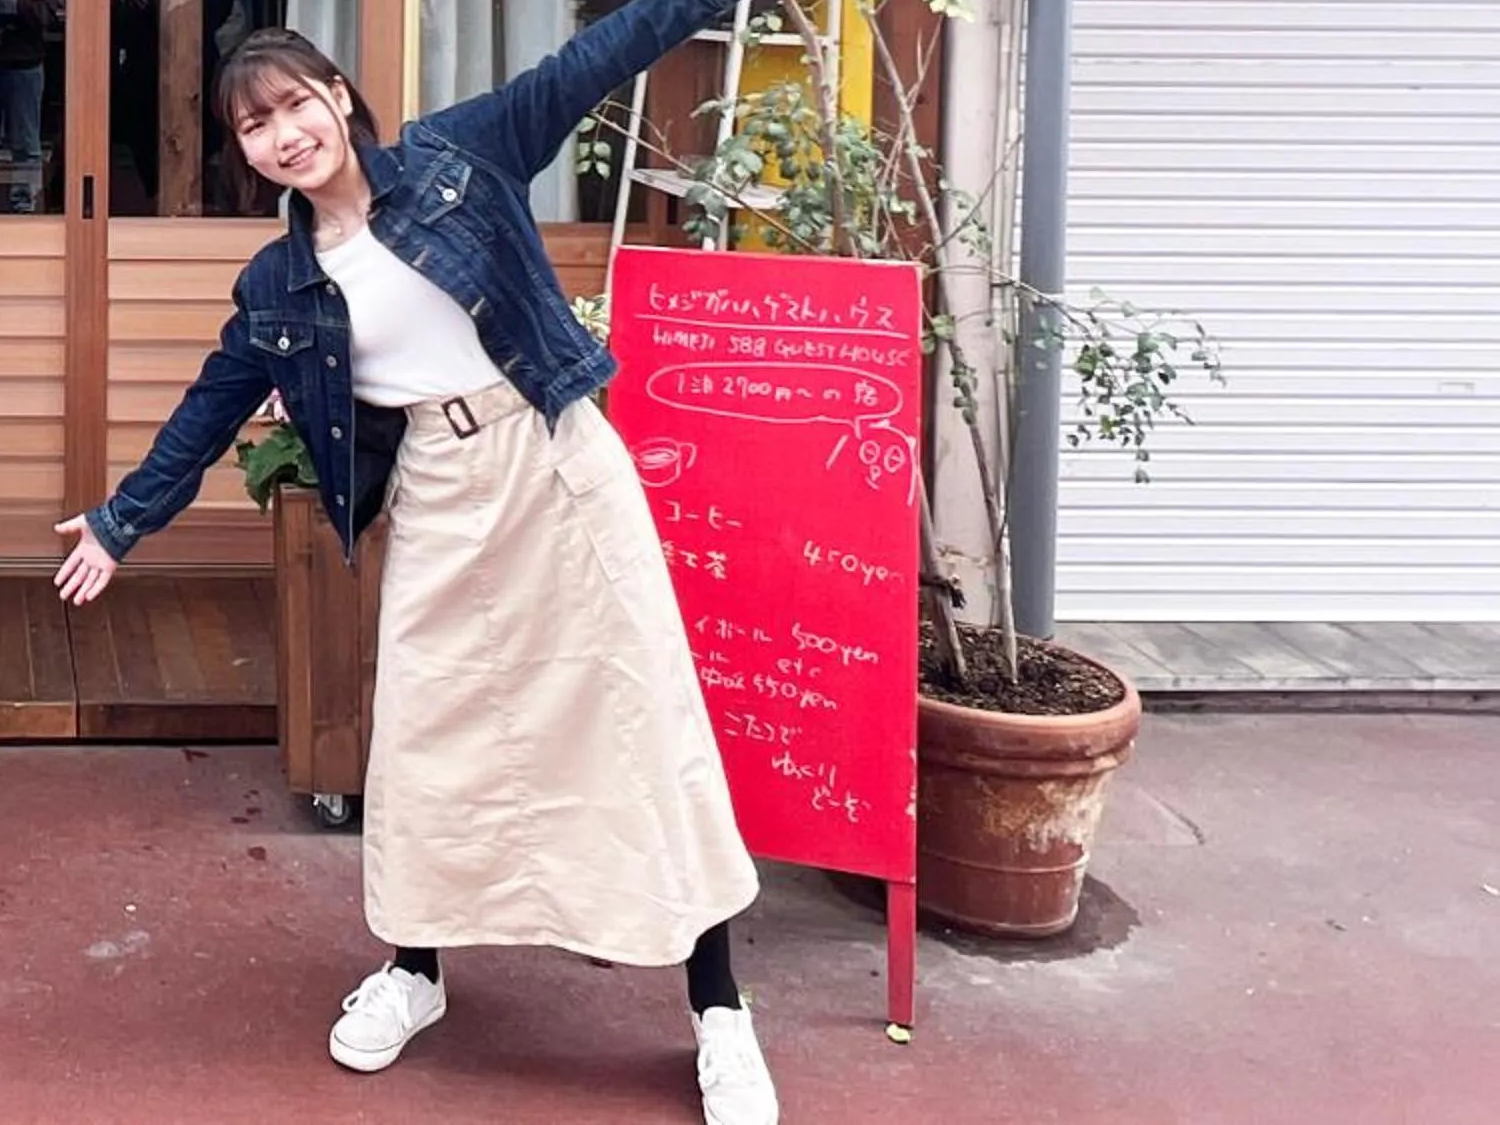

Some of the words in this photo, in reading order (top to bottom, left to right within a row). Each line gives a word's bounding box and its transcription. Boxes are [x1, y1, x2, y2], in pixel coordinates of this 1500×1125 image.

[728, 334, 768, 358] 588
[665, 500, 742, 531] コーヒー
